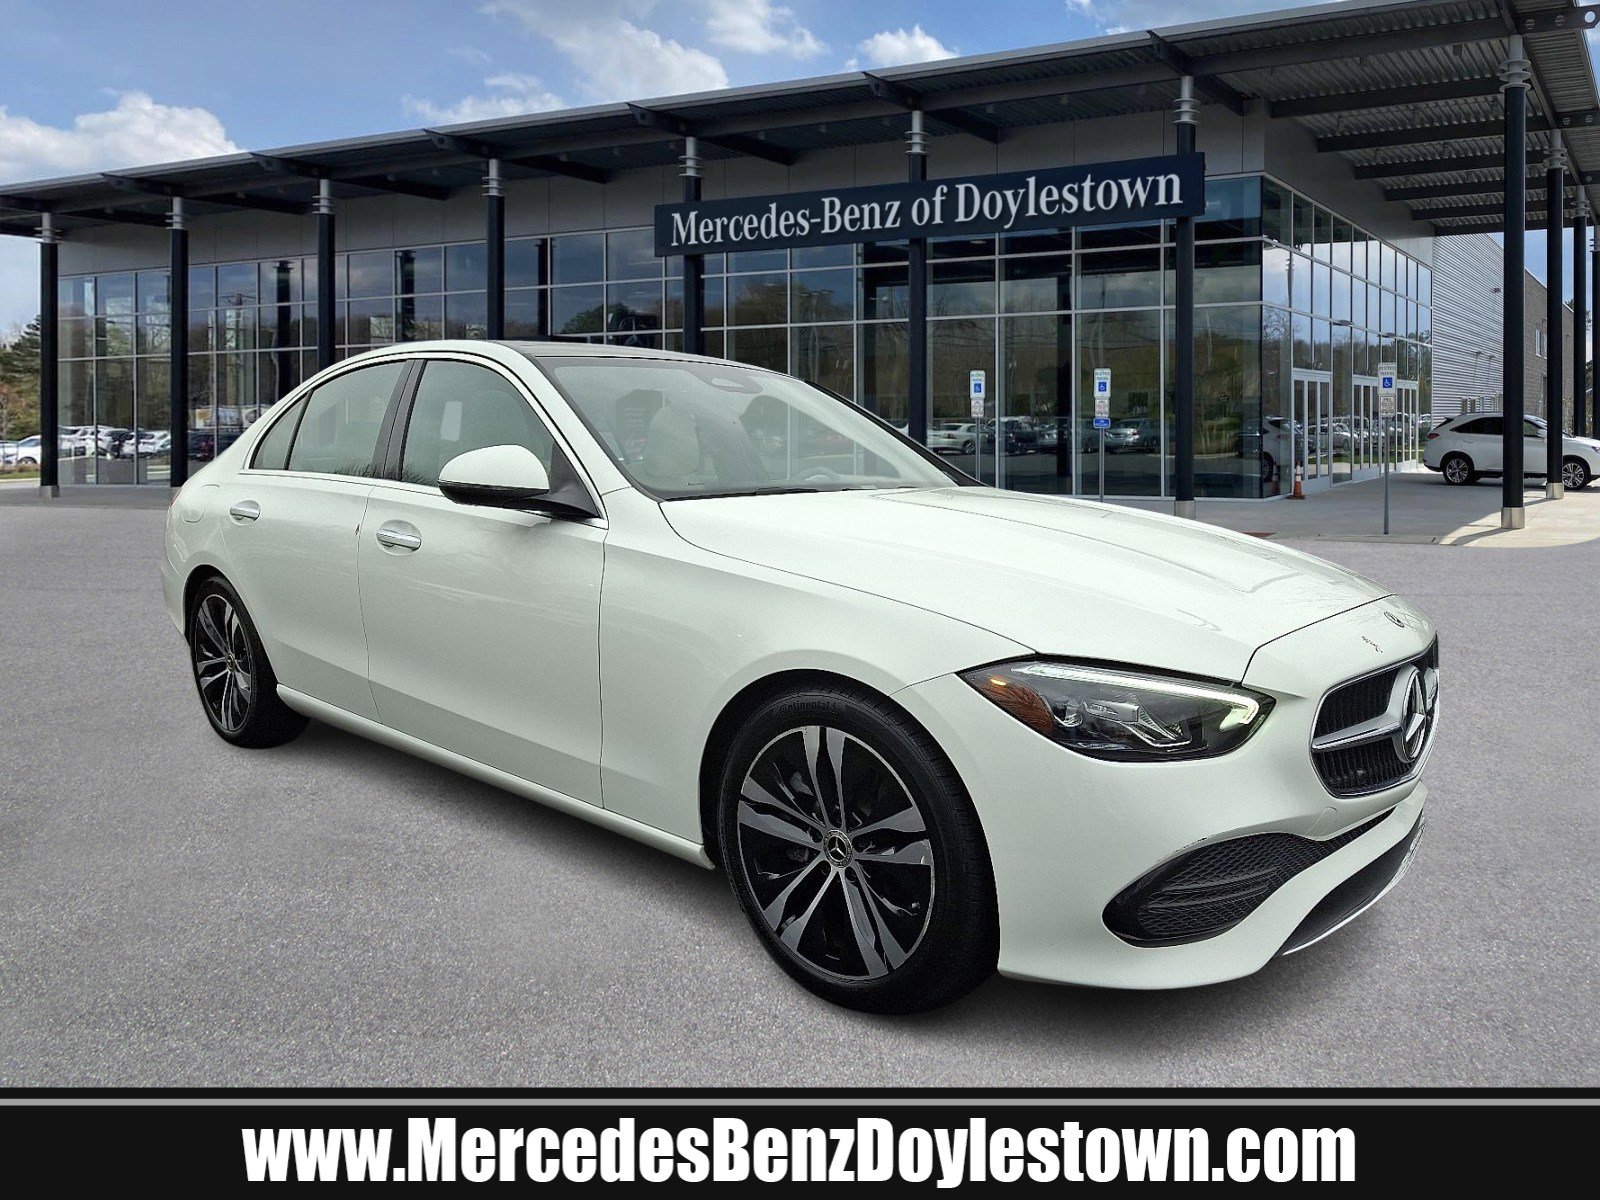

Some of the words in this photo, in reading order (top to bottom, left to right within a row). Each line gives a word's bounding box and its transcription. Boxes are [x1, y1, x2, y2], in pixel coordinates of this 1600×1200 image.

[671, 197, 901, 246] Mercedes-Benz
[911, 184, 948, 226] of
[955, 173, 1183, 228] Doylestown
[780, 701, 830, 714] Continental
